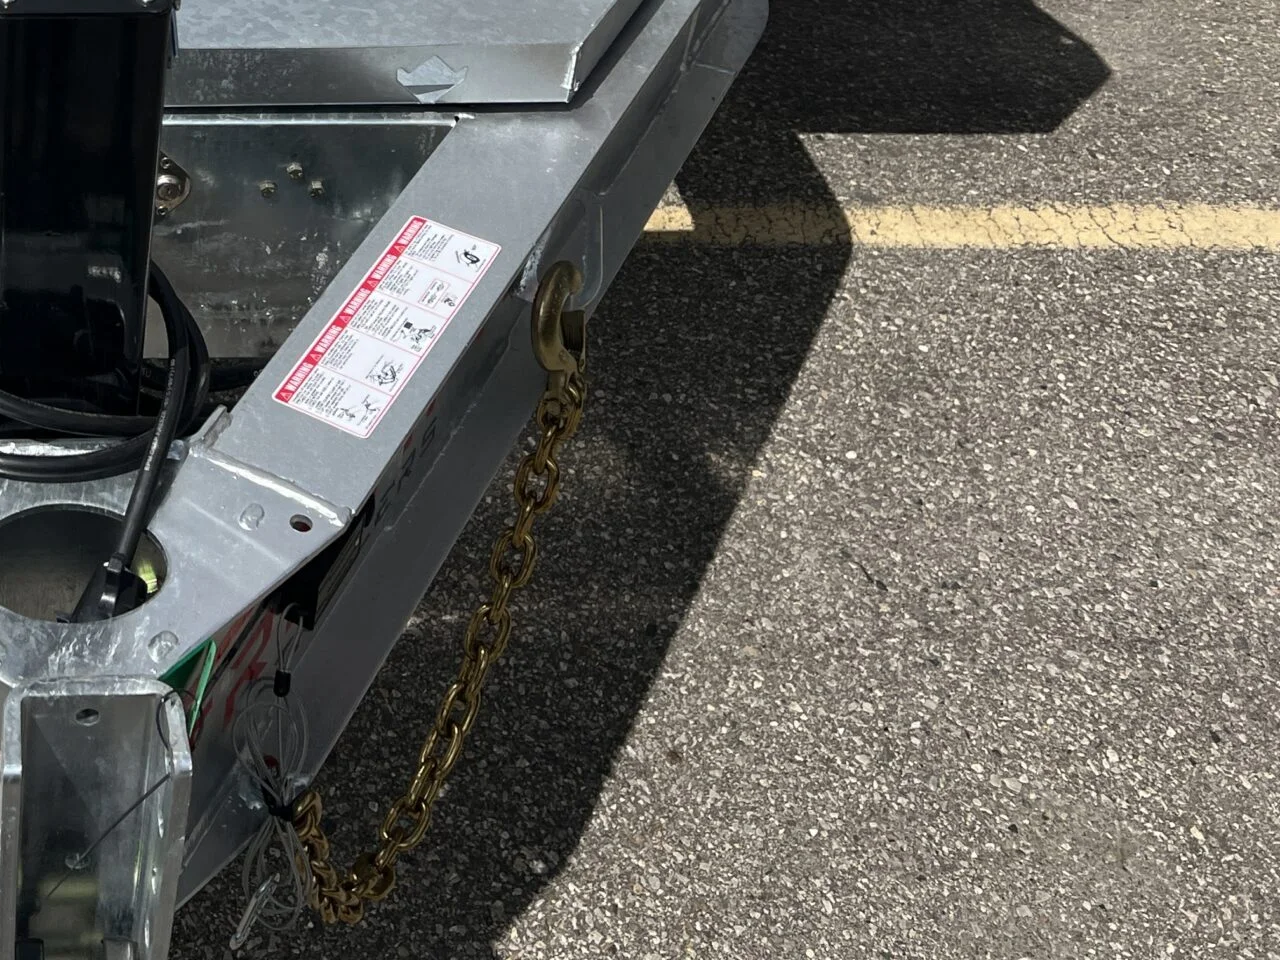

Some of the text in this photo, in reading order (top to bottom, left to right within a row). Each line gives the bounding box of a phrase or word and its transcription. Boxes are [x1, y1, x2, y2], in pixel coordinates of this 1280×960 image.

[399, 219, 423, 245] WARNING
[372, 254, 397, 281] WARNING
[346, 288, 370, 315] WARNING
[316, 324, 342, 353] WARNING
[288, 362, 311, 392] WARNING
